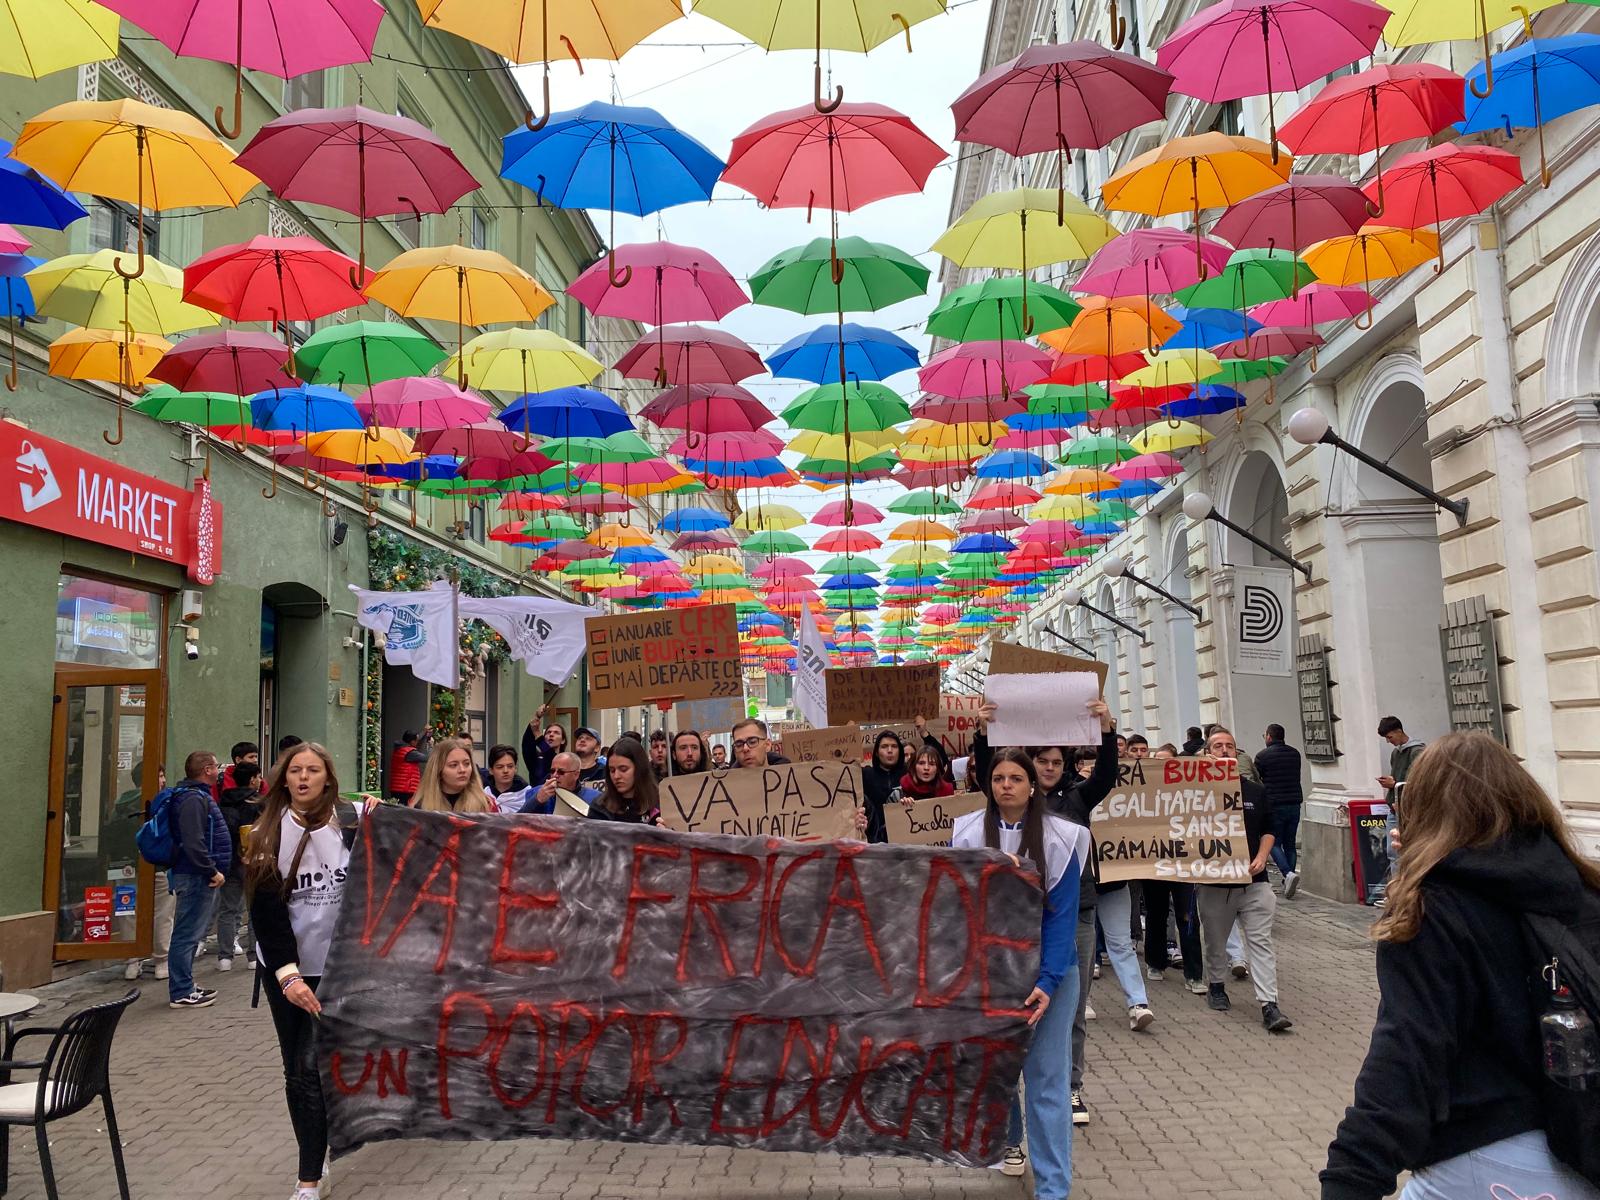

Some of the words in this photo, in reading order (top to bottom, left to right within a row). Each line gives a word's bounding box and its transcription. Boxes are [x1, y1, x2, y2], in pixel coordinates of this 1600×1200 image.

[77, 468, 177, 544] MARKET
[649, 660, 719, 686] DEPARTE
[723, 658, 743, 679] CE
[1164, 760, 1240, 785] BURSE
[668, 771, 739, 823] VĂ
[763, 759, 857, 814] PASĂ
[1223, 792, 1243, 811] DE
[1199, 838, 1233, 860] UN
[1154, 858, 1251, 879] SLOGAN
[491, 826, 566, 964] E
[912, 855, 1042, 1019] DE
[330, 1048, 410, 1100] UN
[436, 990, 690, 1128] POPOR
